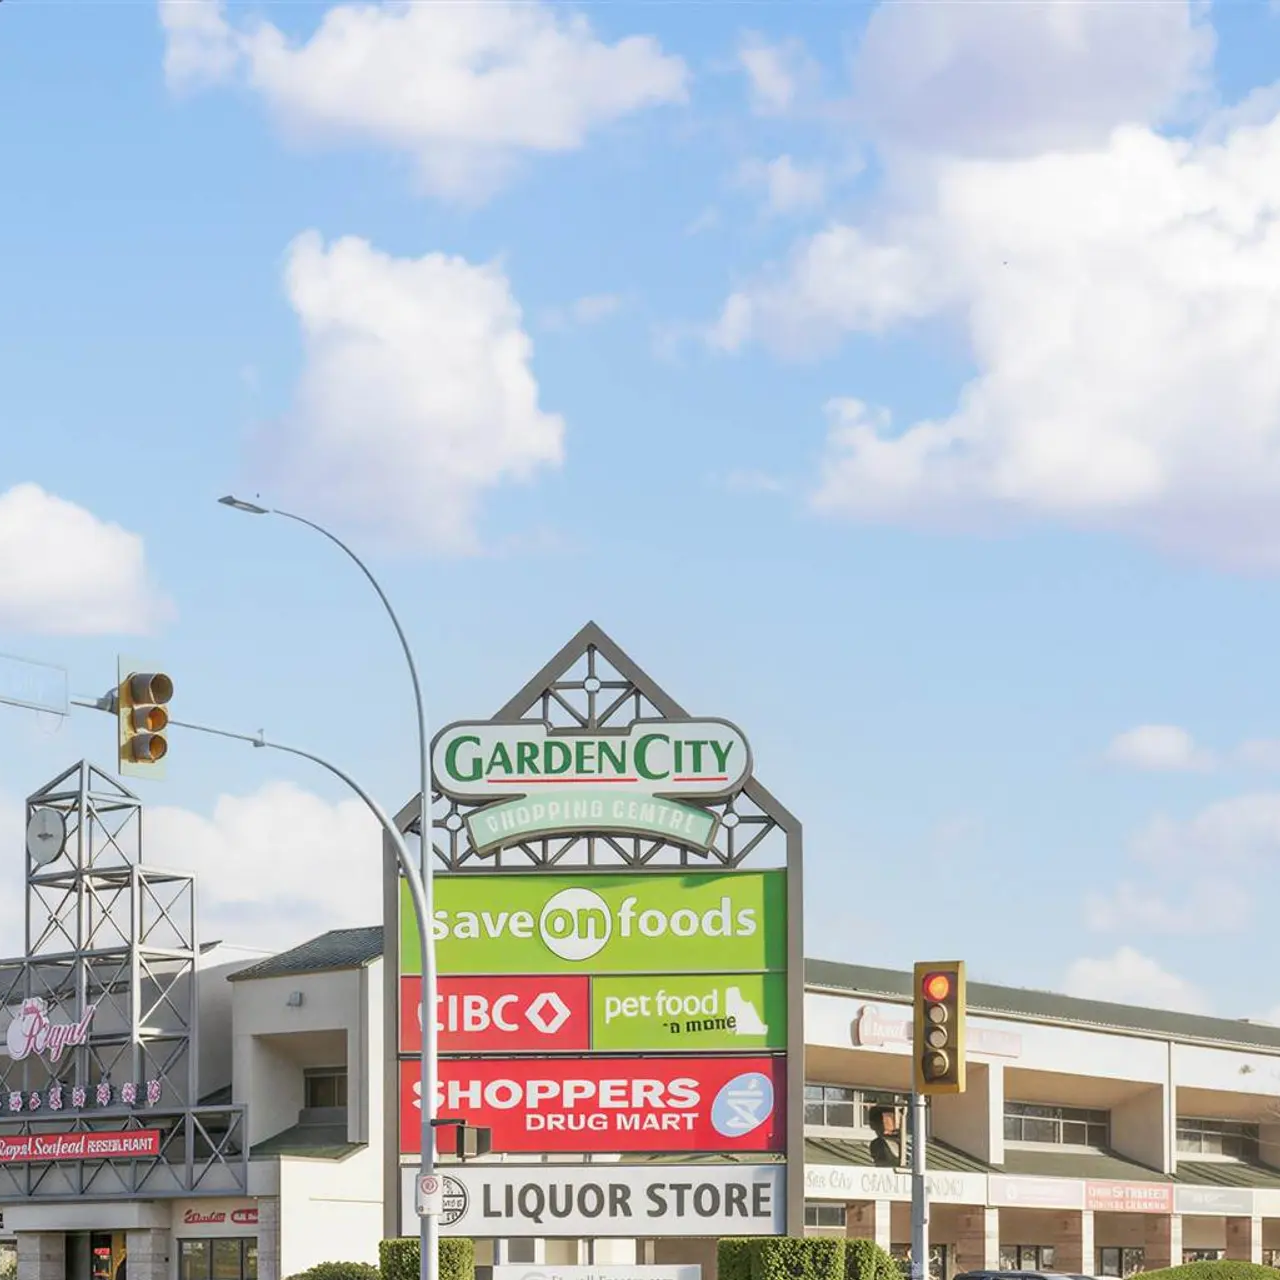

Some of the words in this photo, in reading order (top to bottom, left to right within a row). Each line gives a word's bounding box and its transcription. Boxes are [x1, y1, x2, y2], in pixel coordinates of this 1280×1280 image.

[444, 735, 627, 782] GARDEN
[633, 733, 734, 780] CITY
[431, 907, 534, 940] save
[545, 907, 606, 940] on
[618, 897, 757, 937] foods
[605, 995, 651, 1024] pet
[655, 988, 718, 1017] food
[526, 1113, 609, 1132] DRUG
[616, 1112, 700, 1131] MART
[482, 1183, 633, 1225] LIQUOR
[646, 1182, 772, 1219] STORE
